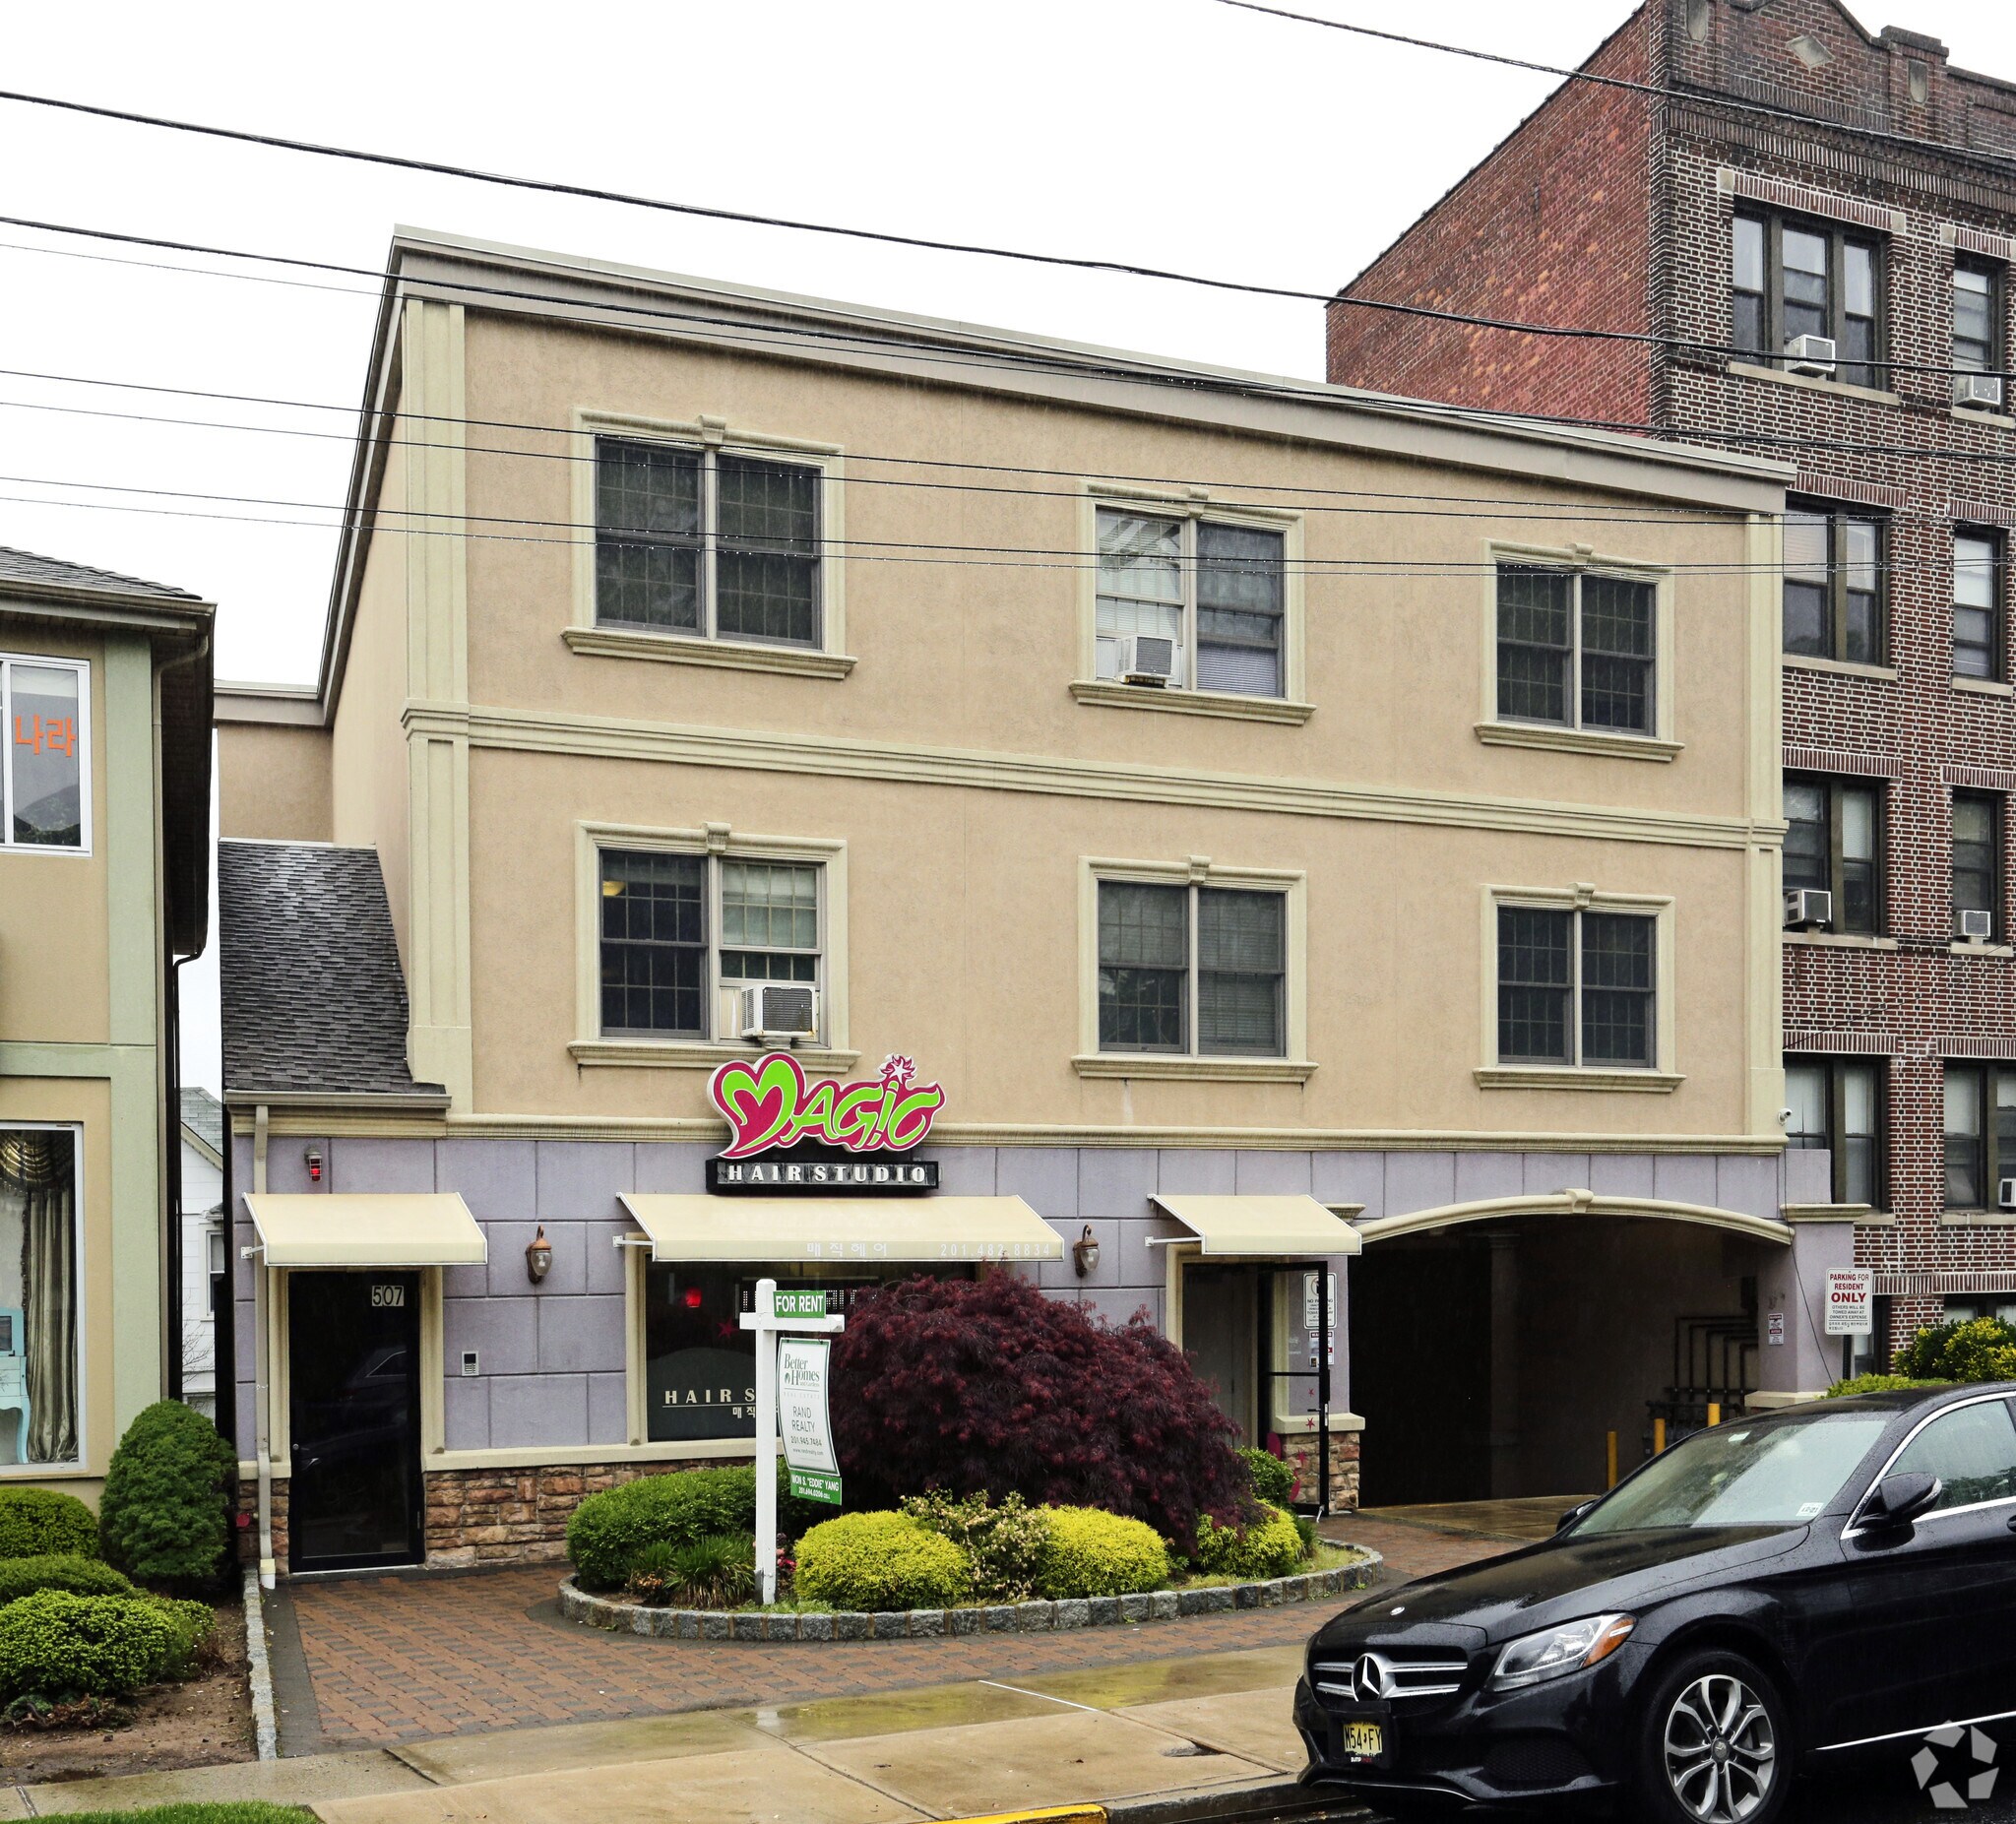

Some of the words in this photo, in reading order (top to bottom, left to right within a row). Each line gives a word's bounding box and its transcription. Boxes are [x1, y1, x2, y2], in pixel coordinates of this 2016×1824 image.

[15, 714, 77, 758] 나라
[1829, 1273, 1857, 1282] PARKING
[372, 1286, 403, 1306] 507
[775, 1294, 796, 1312] FOR
[798, 1294, 824, 1313] RENT
[1831, 1291, 1867, 1303] ONLY
[784, 1352, 809, 1370] Better
[790, 1369, 820, 1386] Homes
[664, 1388, 732, 1405] HAIR
[792, 1406, 812, 1419] RAND
[791, 1419, 816, 1433] REALTY
[825, 1479, 840, 1492] YANG
